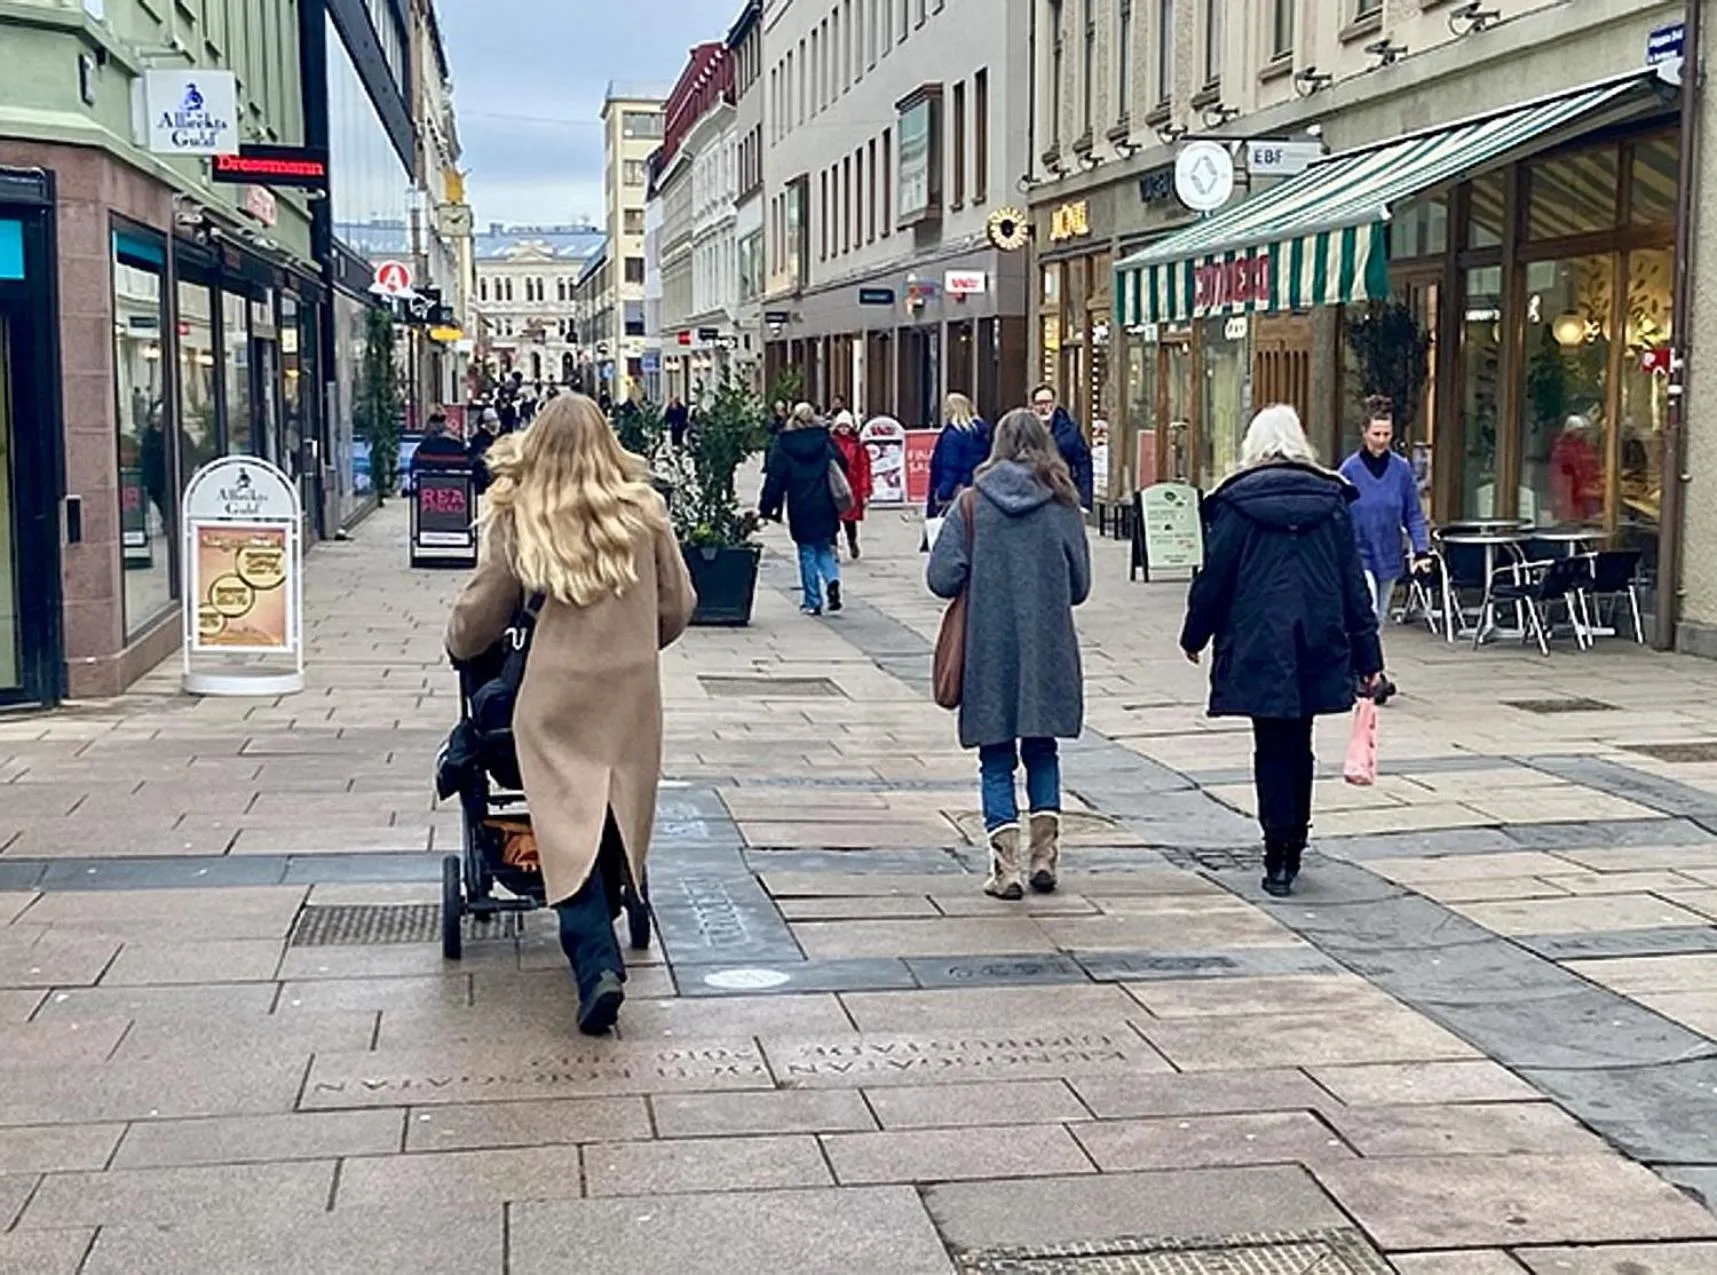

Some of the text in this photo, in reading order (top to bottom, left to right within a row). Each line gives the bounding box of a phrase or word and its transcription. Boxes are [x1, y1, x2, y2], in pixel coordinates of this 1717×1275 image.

[171, 130, 217, 148] Guld
[217, 156, 324, 176] Dressmann
[422, 487, 465, 504] REA
